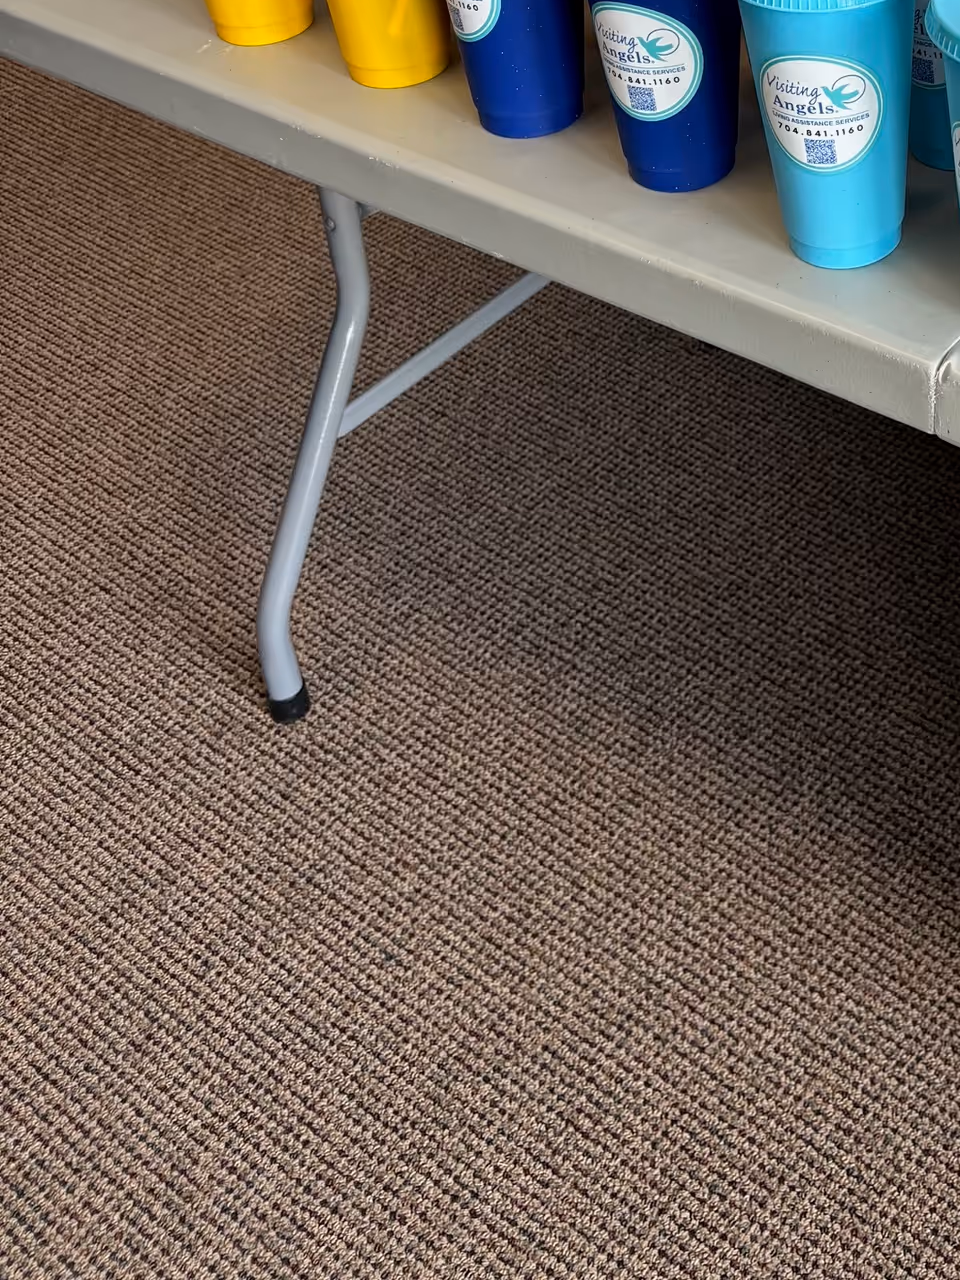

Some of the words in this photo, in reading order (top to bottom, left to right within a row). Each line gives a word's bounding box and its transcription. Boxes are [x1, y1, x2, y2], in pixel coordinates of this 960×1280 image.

[596, 20, 639, 54] Visiting
[607, 66, 681, 86] 704.841.1160
[652, 66, 686, 75] SERVICES
[766, 72, 822, 105] Visiting
[772, 110, 790, 122] LIVING
[790, 117, 834, 127] ASSISTANCE
[835, 112, 870, 126] SERVICES
[777, 121, 864, 138] 704.841.1160
